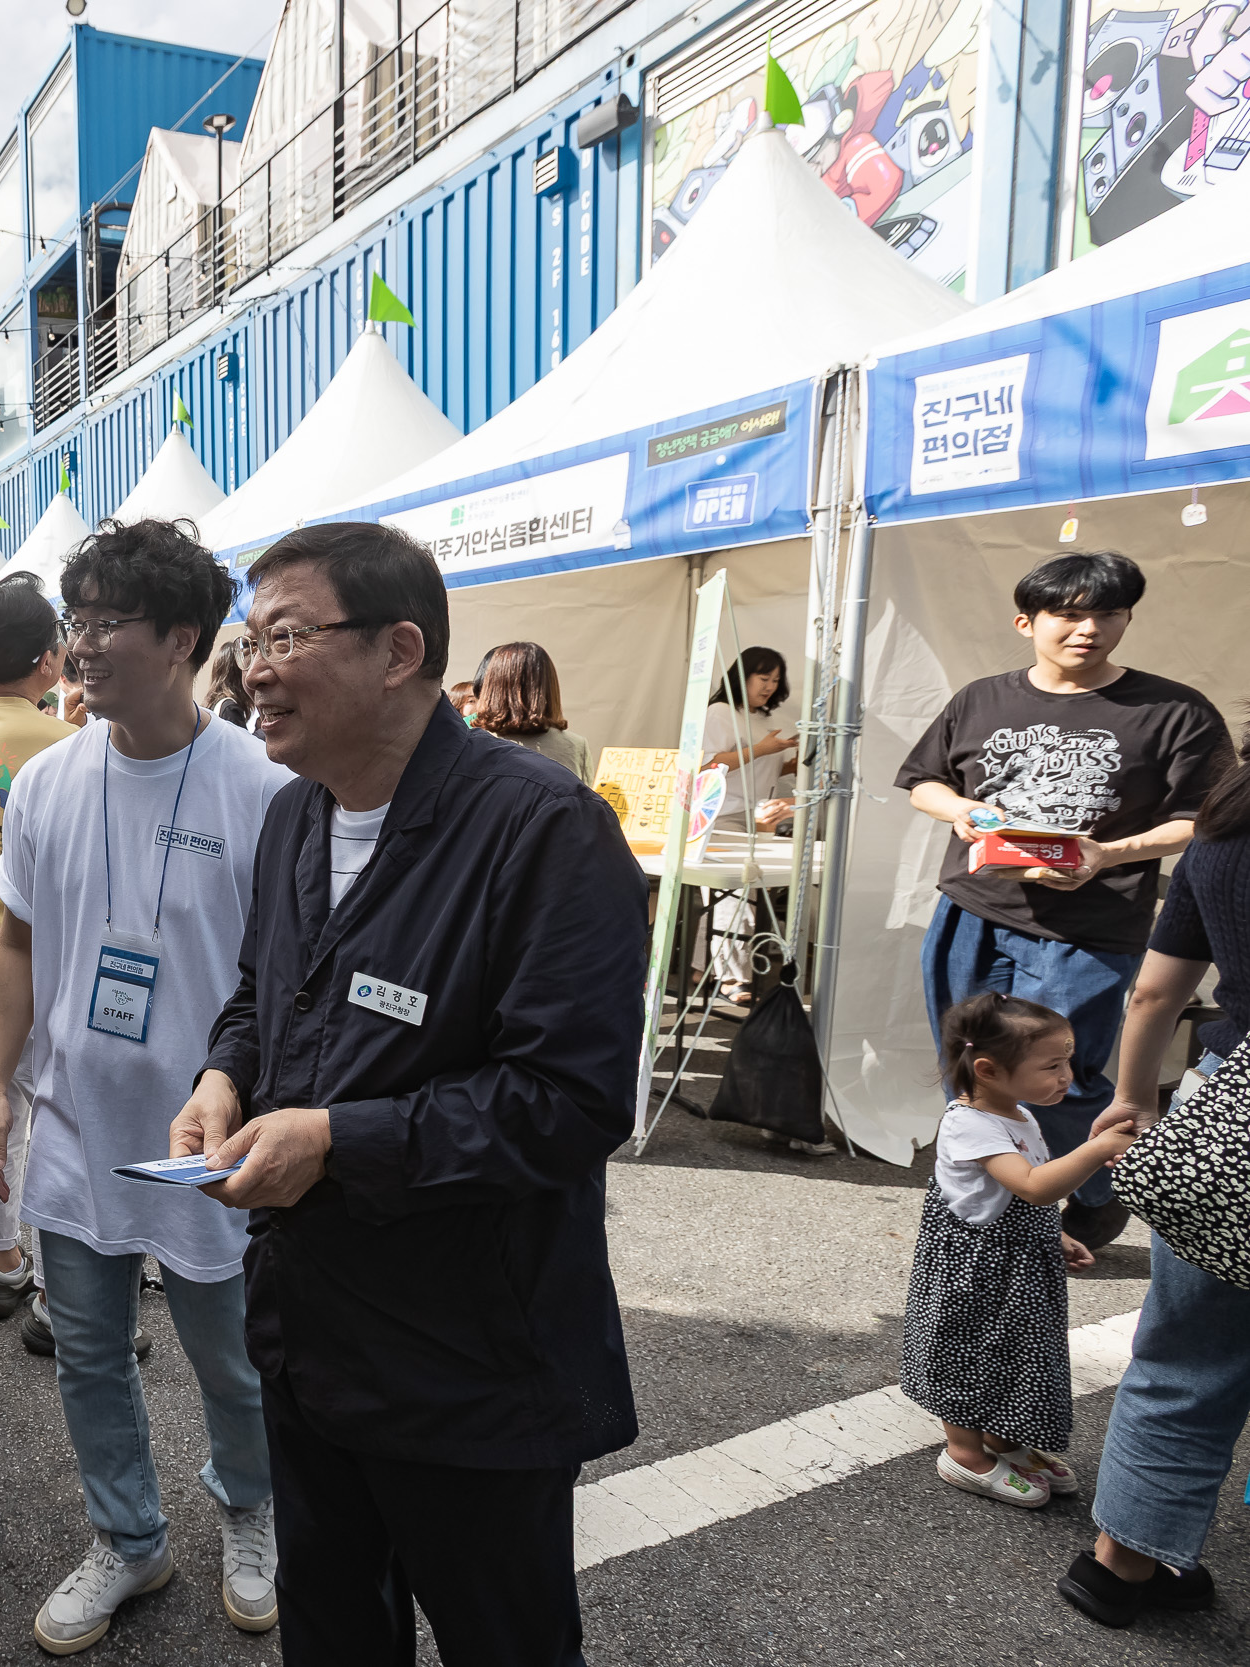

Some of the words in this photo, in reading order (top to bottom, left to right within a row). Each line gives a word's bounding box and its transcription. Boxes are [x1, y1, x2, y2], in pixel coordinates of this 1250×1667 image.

[580, 190, 591, 277] CODE
[922, 384, 1014, 428] 진구네
[655, 433, 698, 459] 청년정책
[700, 423, 739, 448] 궁금해?
[923, 423, 1013, 465] 편의점
[692, 494, 746, 525] OPEN
[1044, 750, 1122, 772] BASS
[159, 829, 189, 846] 진구네
[190, 835, 223, 854] 편의점
[103, 1007, 135, 1021] STAFF
[379, 1000, 410, 1017] 광진구청장
